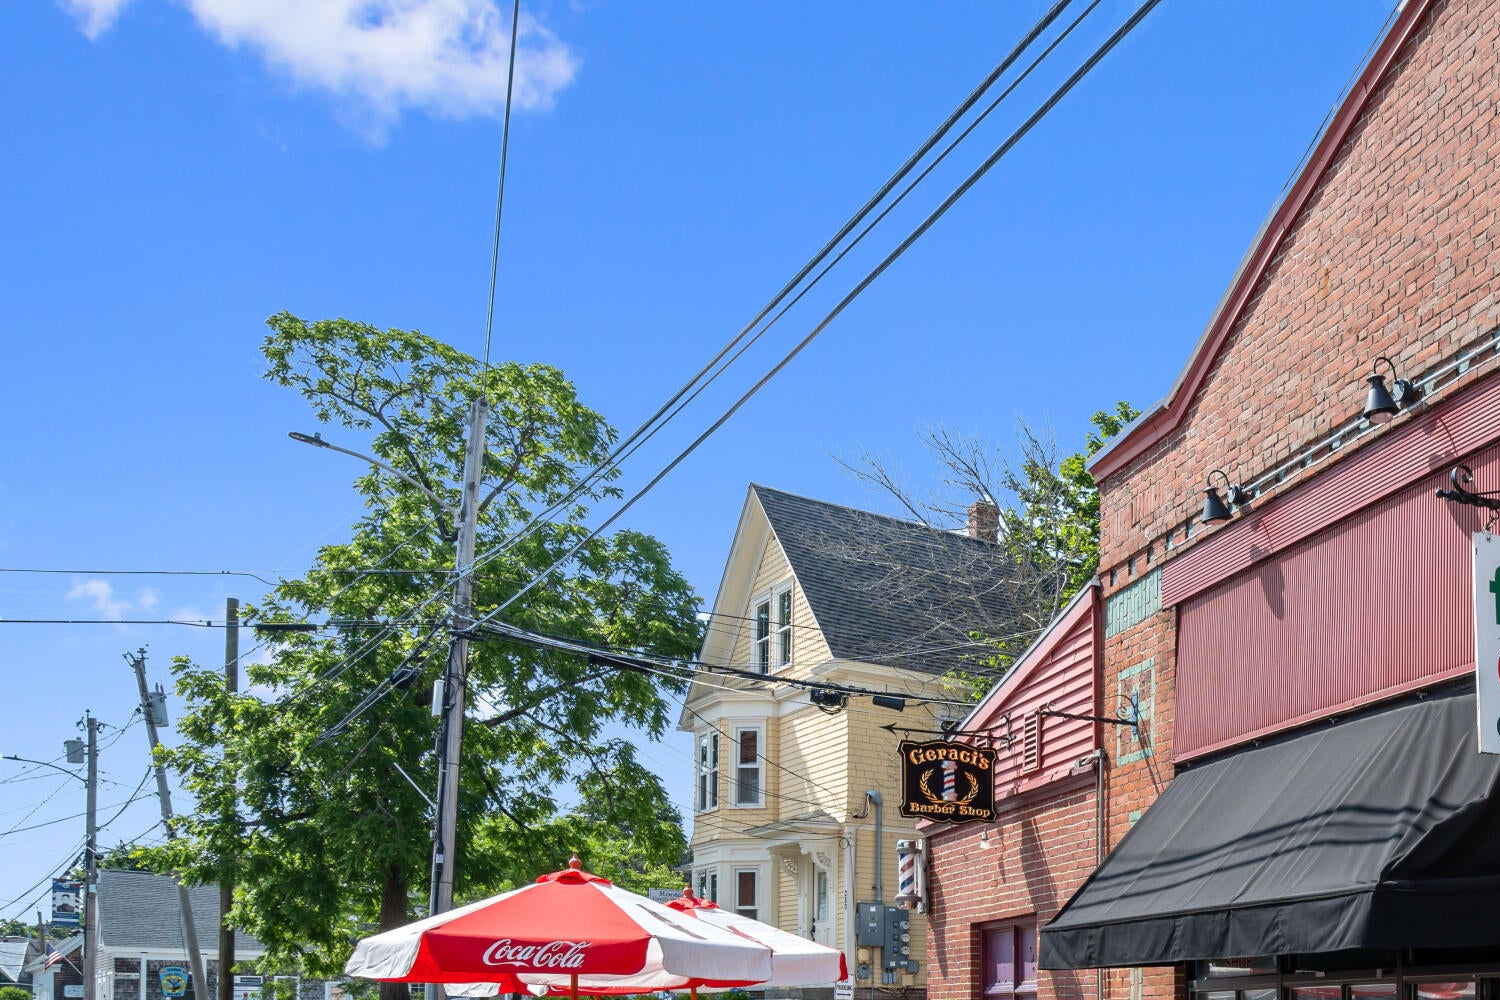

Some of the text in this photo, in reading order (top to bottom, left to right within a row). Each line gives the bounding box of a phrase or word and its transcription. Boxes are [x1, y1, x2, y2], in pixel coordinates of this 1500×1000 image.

[909, 748, 990, 770] Geraci's
[909, 802, 991, 818] Barber Shop
[482, 939, 592, 968] Coca-Cola
